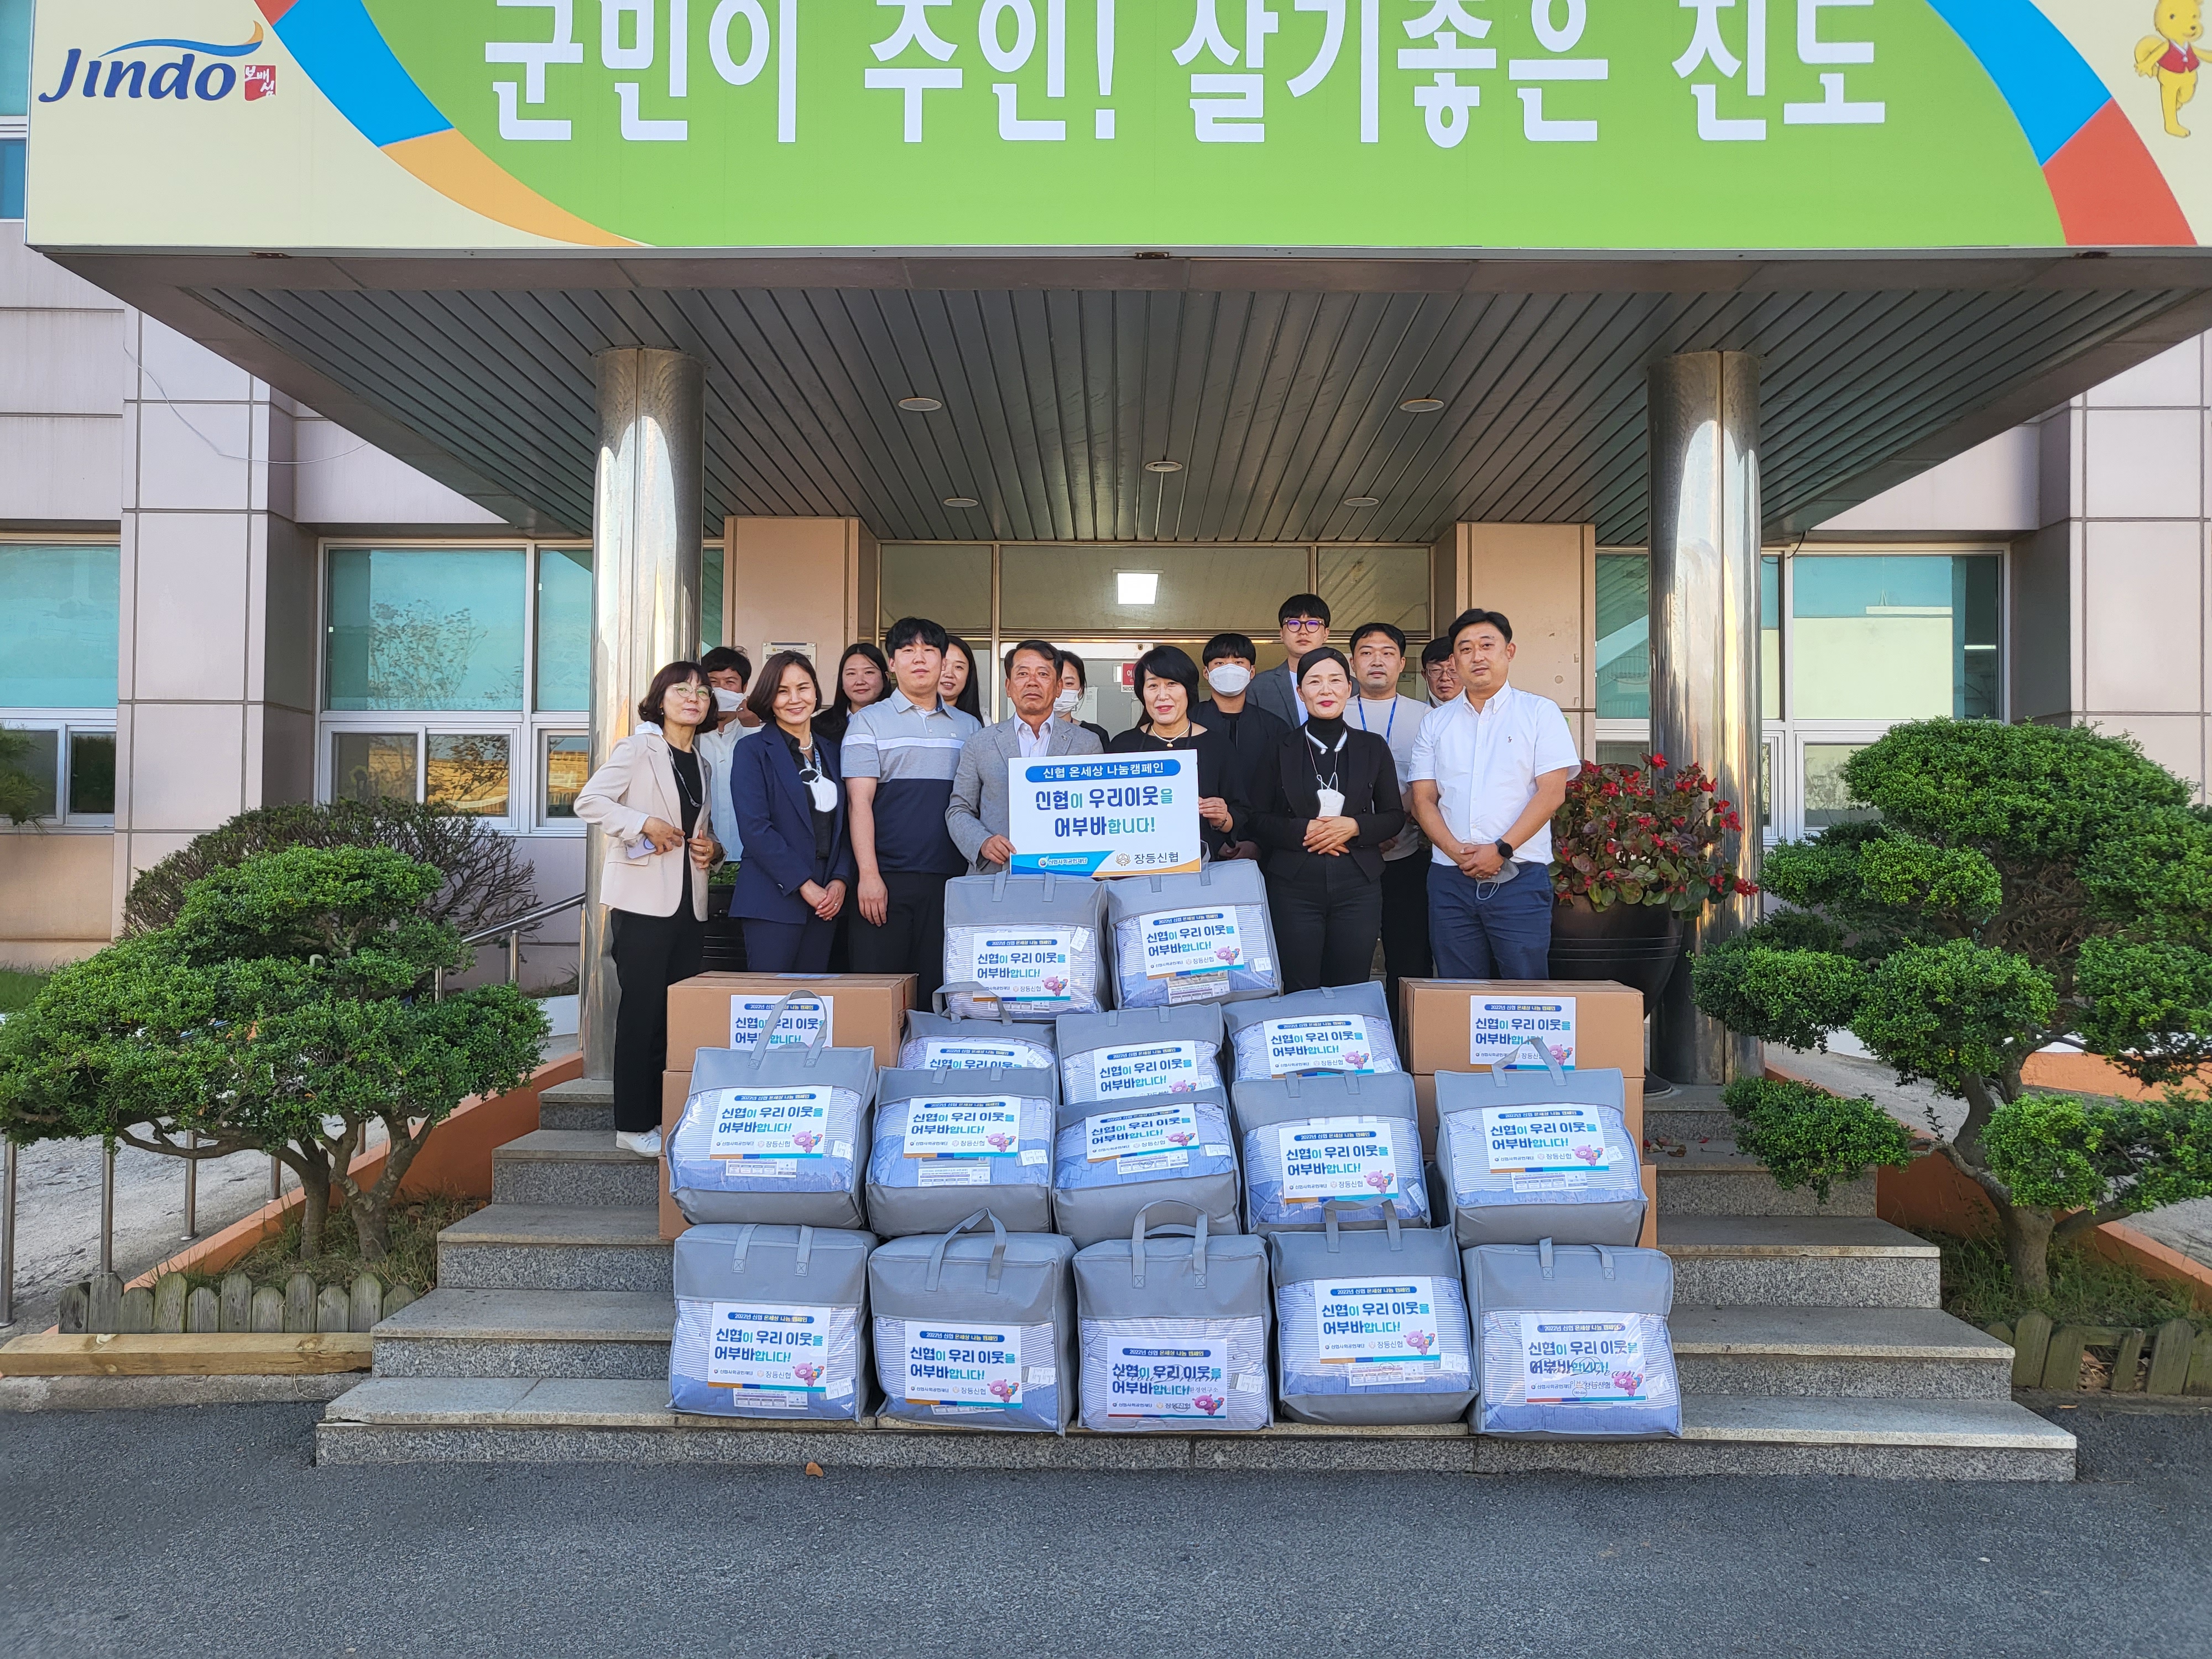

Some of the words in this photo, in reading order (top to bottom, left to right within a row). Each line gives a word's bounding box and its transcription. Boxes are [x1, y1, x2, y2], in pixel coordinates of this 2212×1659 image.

[38, 48, 237, 103] Jindo
[485, 0, 797, 143] 군민이
[864, 0, 1115, 143] 주인!
[1172, 0, 1609, 148] 살기좋은
[1672, 0, 1885, 141] 진도
[1043, 768, 1065, 779] 신협
[1069, 765, 1103, 778] 온세상
[1107, 762, 1164, 776] 나눔캠페인
[1036, 790, 1083, 811] 신협이
[1089, 785, 1173, 808] 우리이웃을
[1055, 817, 1155, 837] 어부바합니다!
[1134, 852, 1178, 864] 장등신협
[1147, 931, 1177, 943] 신협이
[1180, 927, 1201, 938] 우리
[1204, 925, 1234, 936] 이웃을
[1149, 941, 1211, 956] 어부바합니다!
[978, 953, 1008, 964] 신협이
[1010, 952, 1032, 963] 우리
[1035, 952, 1066, 963] 이웃을
[978, 967, 1040, 978] 어부바합니다!
[1475, 1018, 1508, 1030] 신협이
[1511, 1019, 1534, 1030] 우리
[1538, 1019, 1571, 1031] 이웃을
[1271, 1035, 1303, 1045] 신협이
[1306, 1032, 1328, 1042] 우리
[1331, 1031, 1363, 1040] 이웃을
[1273, 1045, 1339, 1057] 어부바합니다!
[1100, 1066, 1131, 1078] 신협이
[1134, 1061, 1156, 1073] 우리
[1160, 1058, 1192, 1070] 이웃을
[1101, 1075, 1166, 1092] 어부바합니다!
[722, 1108, 757, 1119] 신협이
[759, 1107, 785, 1118] 우리
[788, 1106, 823, 1117] 이웃을
[913, 1113, 948, 1123] 신협이
[951, 1113, 976, 1121] 우리
[980, 1112, 1015, 1121] 이웃을
[719, 1121, 792, 1133] 어부바합니다!
[911, 1125, 985, 1134] 어부바합니다!
[1092, 1125, 1125, 1136] 신협이
[1129, 1121, 1152, 1129] 우리
[1157, 1117, 1191, 1125] 이웃을
[1490, 1125, 1527, 1136] 신협이
[1530, 1123, 1556, 1134] 우리
[1560, 1122, 1597, 1133] 이웃을
[1092, 1129, 1163, 1145] 어부바합니다!
[1493, 1138, 1568, 1150] 어부바합니다!
[1286, 1148, 1322, 1161] 신협이
[1324, 1146, 1349, 1158] 우리
[1353, 1145, 1389, 1157] 이웃을
[1288, 1162, 1361, 1176] 어부바합니다!
[1322, 1304, 1359, 1317] 신협이
[1363, 1302, 1389, 1316] 우리
[1392, 1302, 1430, 1314] 이웃을
[1323, 1321, 1400, 1334] 어부바합니다!
[716, 1328, 753, 1343] 신협이
[756, 1331, 782, 1344] 우리
[786, 1332, 823, 1347] 이웃을
[715, 1347, 791, 1363] 어부바합니다!
[910, 1347, 946, 1361] 신협이
[949, 1349, 974, 1363] 우리
[979, 1350, 1015, 1364] 이웃을
[1528, 1342, 1567, 1356] 신협이
[1570, 1340, 1597, 1355] 우리
[1600, 1340, 1637, 1354] 이웃을
[911, 1364, 985, 1380] 어부바합니다!
[1112, 1363, 1150, 1377] 신협이
[1154, 1365, 1180, 1379] 우리
[1183, 1366, 1221, 1379] 이웃을
[1113, 1381, 1190, 1395] 어부바합니다!
